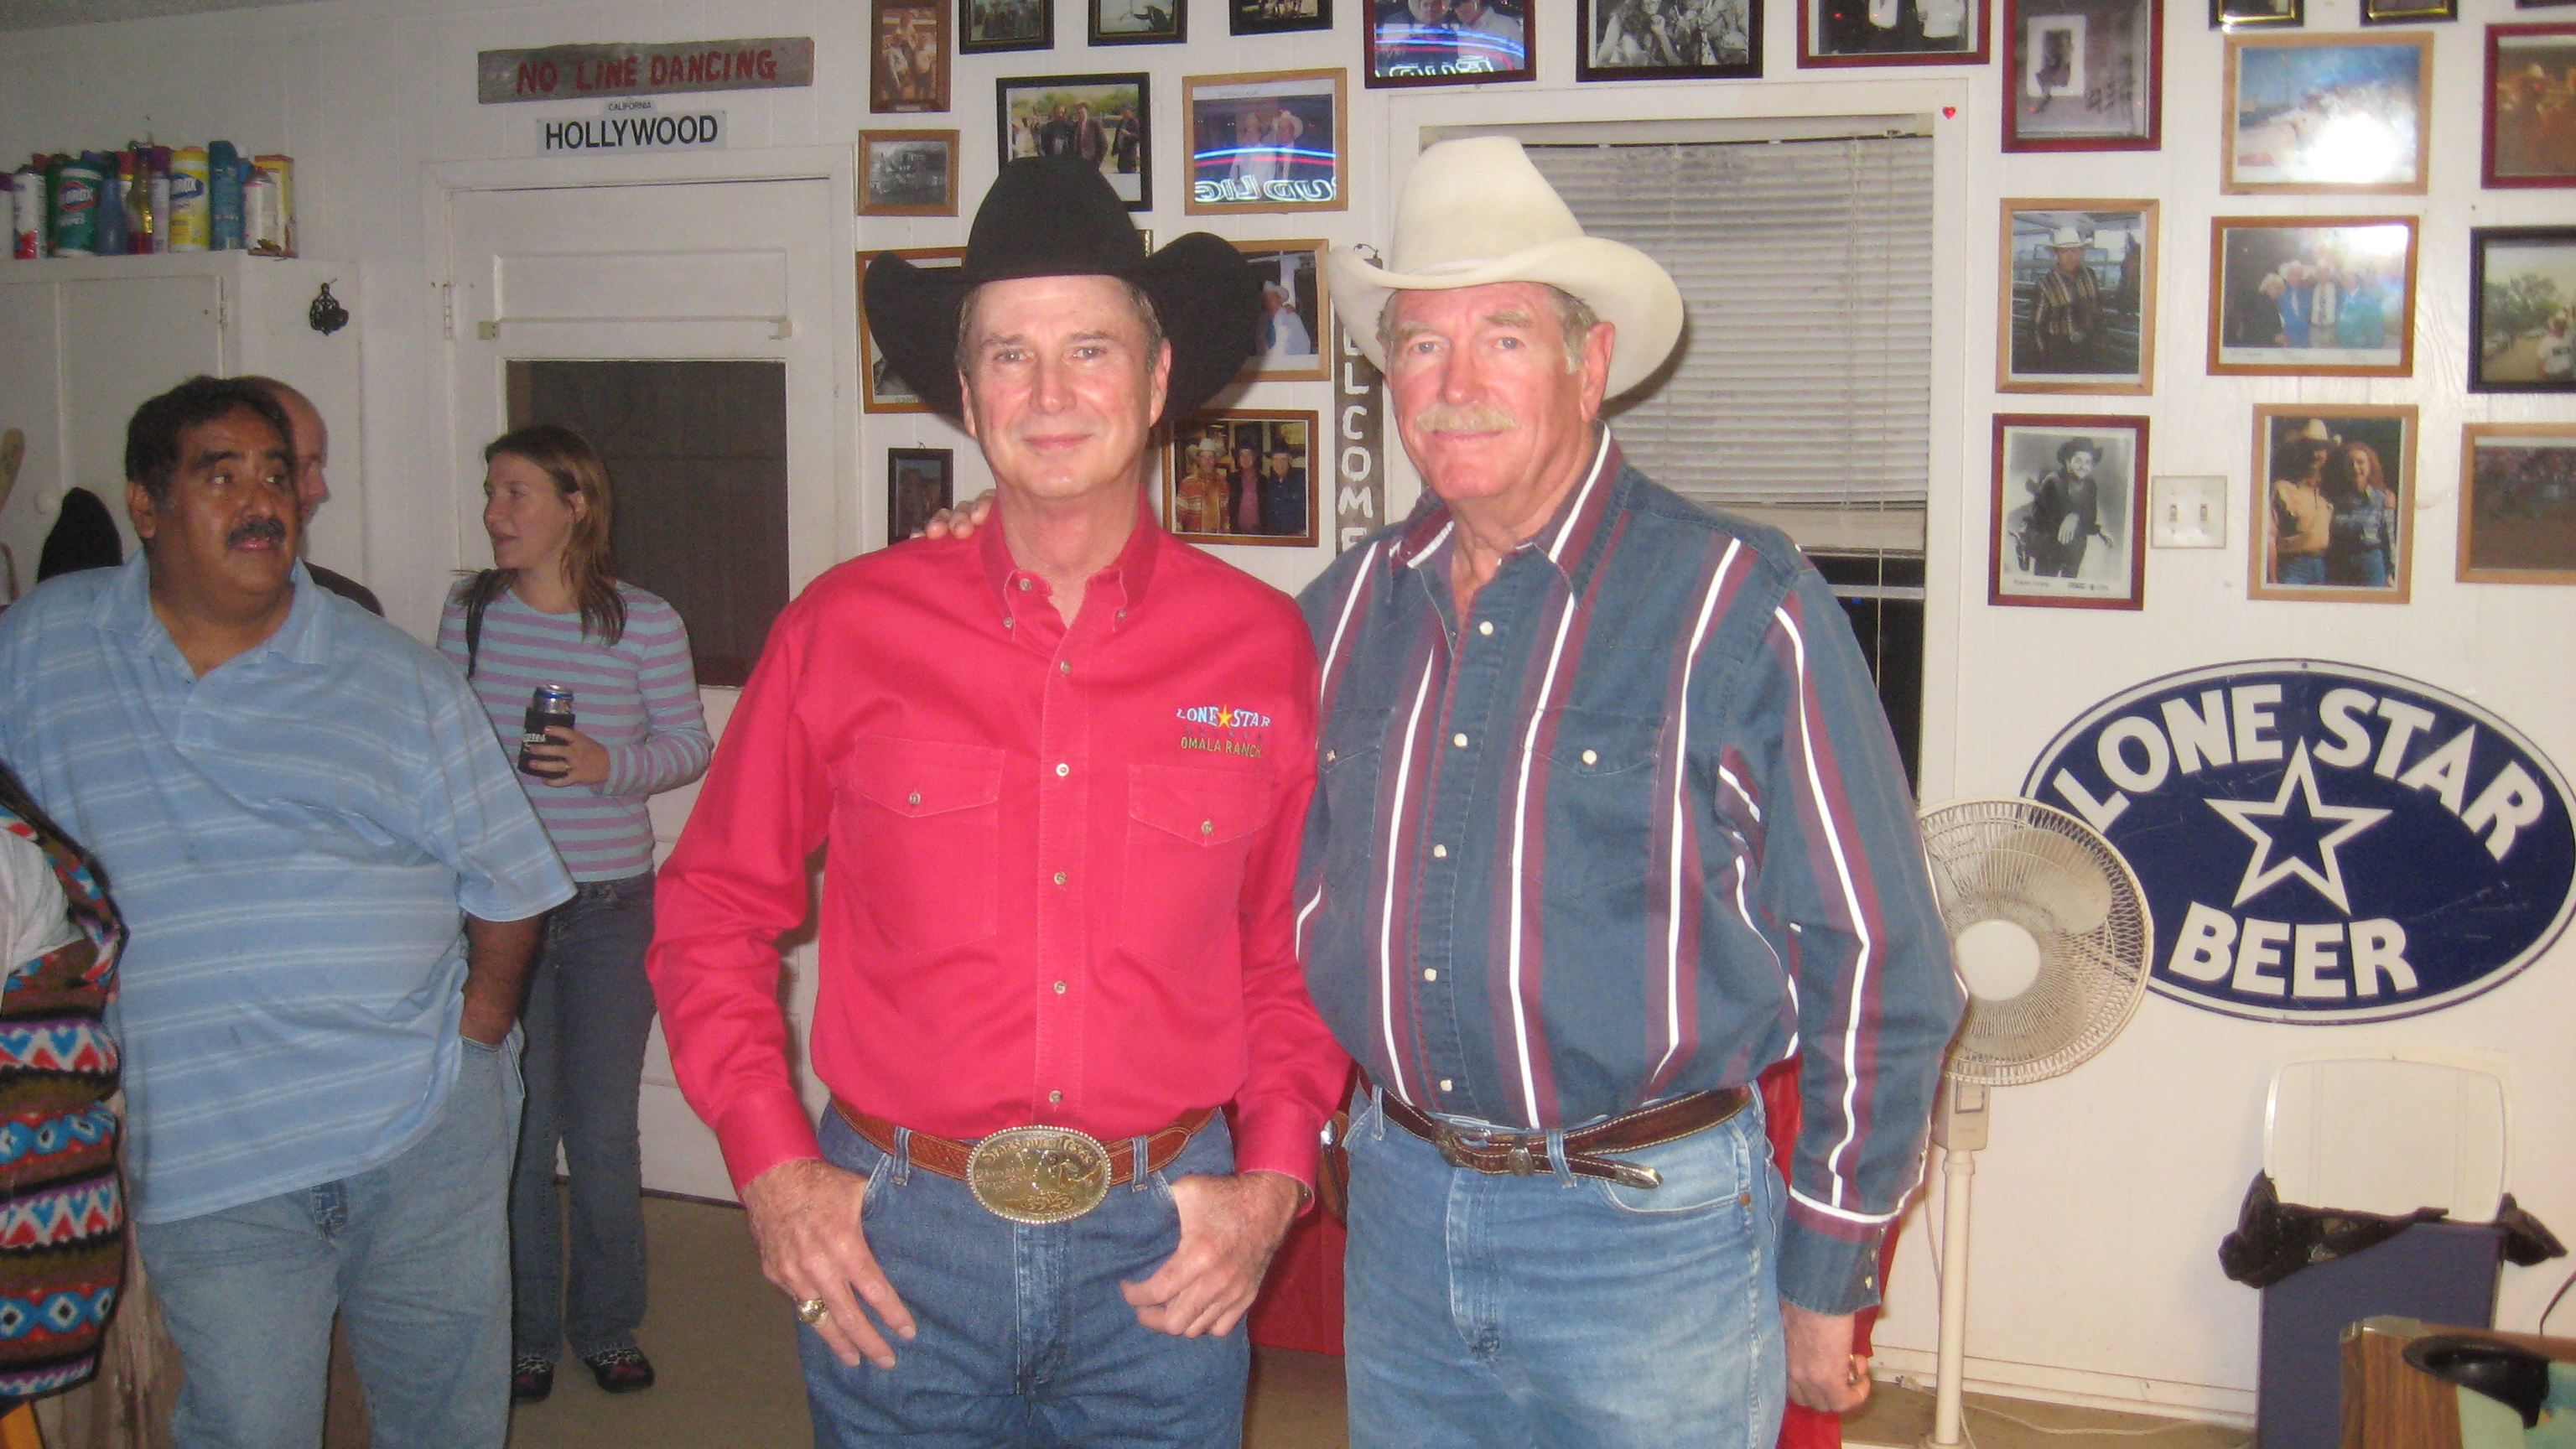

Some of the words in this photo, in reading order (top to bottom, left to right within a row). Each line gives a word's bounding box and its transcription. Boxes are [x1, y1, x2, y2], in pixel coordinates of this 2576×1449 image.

[517, 61, 558, 94] NO
[576, 54, 640, 91] LINE
[650, 49, 778, 86] DANCING
[608, 101, 652, 112] CALIFORNIA
[546, 114, 719, 150] HOLLYWOOD
[1176, 706, 1219, 727] LONE
[1230, 709, 1271, 728] STAR
[1225, 740, 1262, 758] RANCH
[2053, 683, 2283, 834] LONE
[2312, 688, 2545, 862] STAR
[2168, 901, 2418, 999] BEER
[979, 1139, 1022, 1164] STARS
